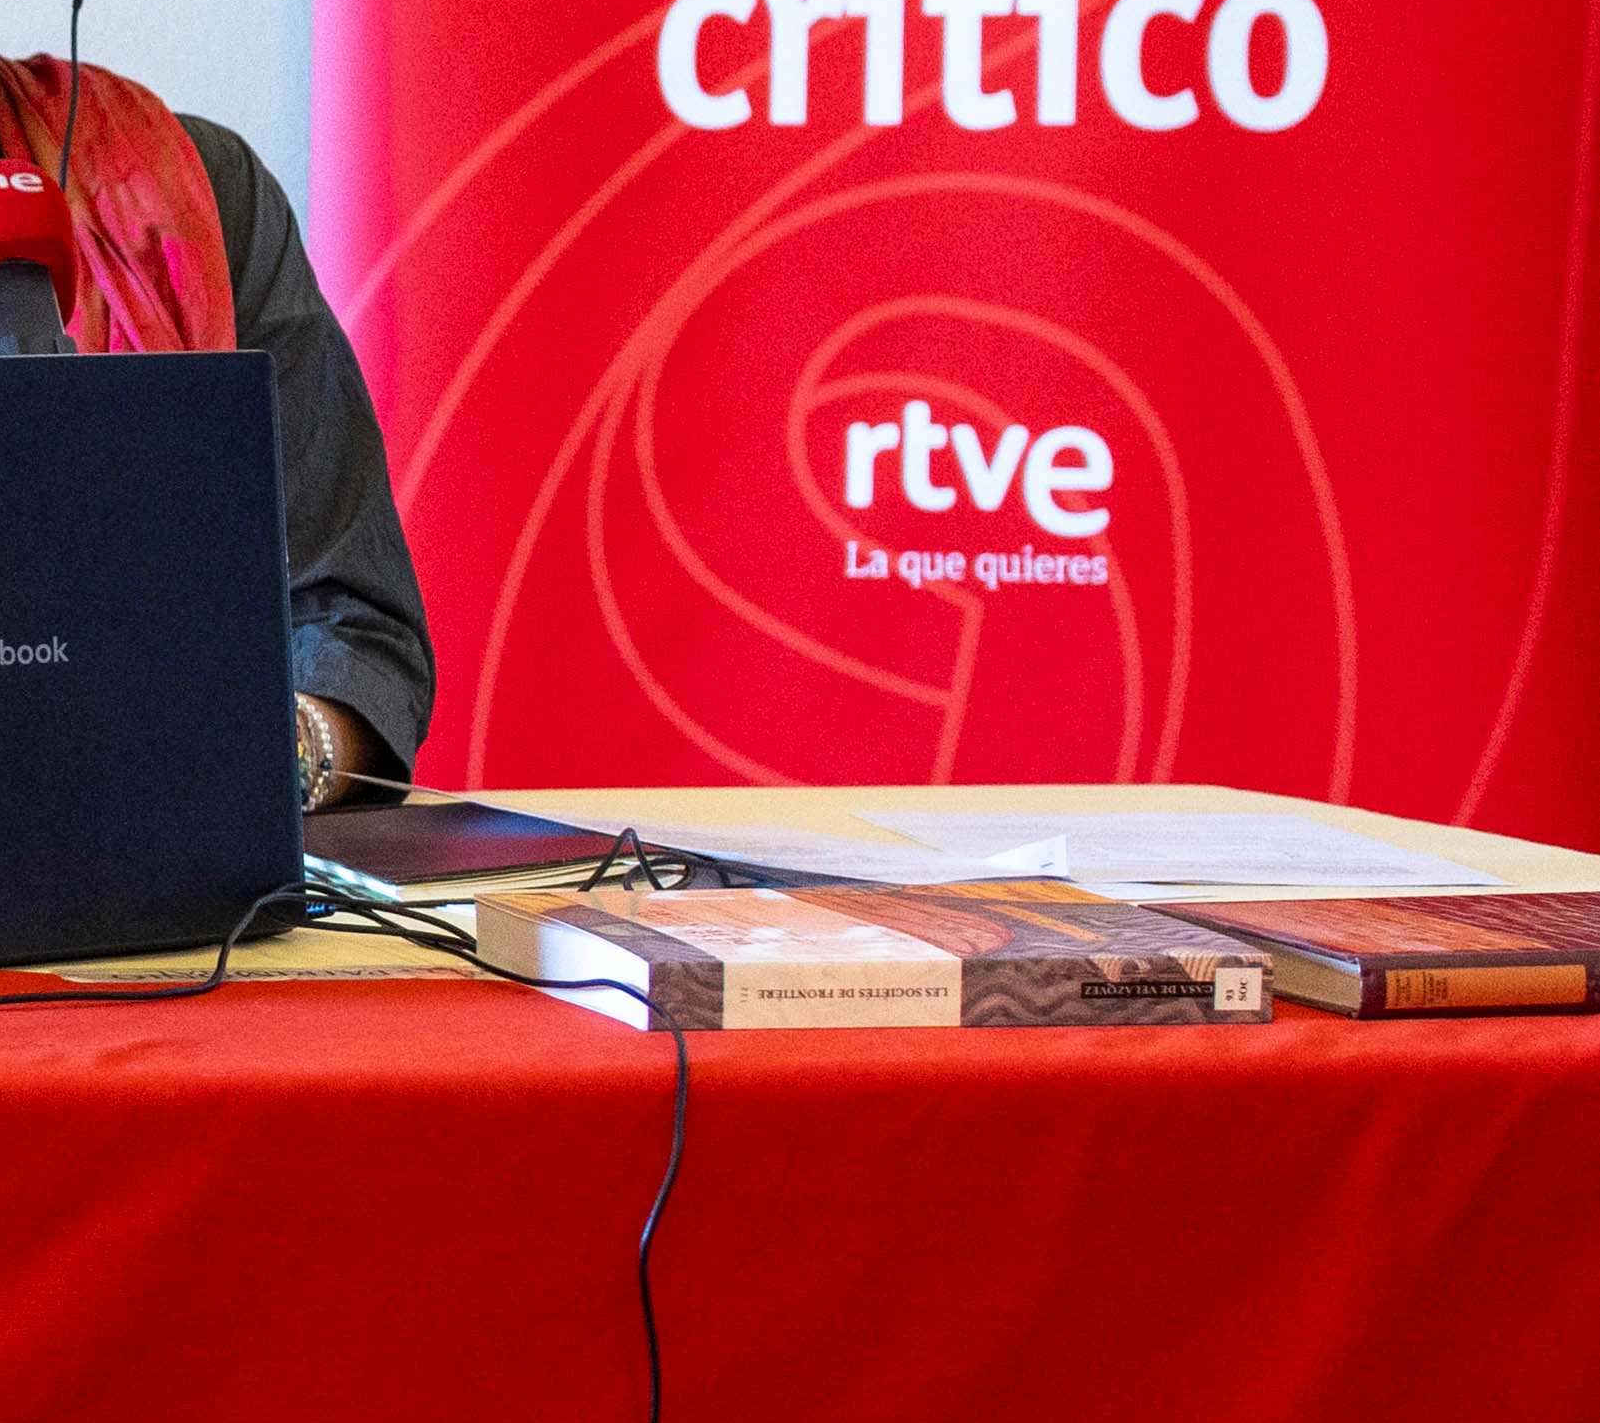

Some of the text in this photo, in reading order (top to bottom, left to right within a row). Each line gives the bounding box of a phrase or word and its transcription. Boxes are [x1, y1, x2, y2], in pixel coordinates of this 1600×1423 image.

[845, 400, 1113, 537] rtve
[845, 540, 1109, 592] La que quieres
[839, 988, 855, 998] DE
[925, 986, 949, 998] LES
[1180, 984, 1214, 994] CASA
[1238, 977, 1249, 1002] SOC
